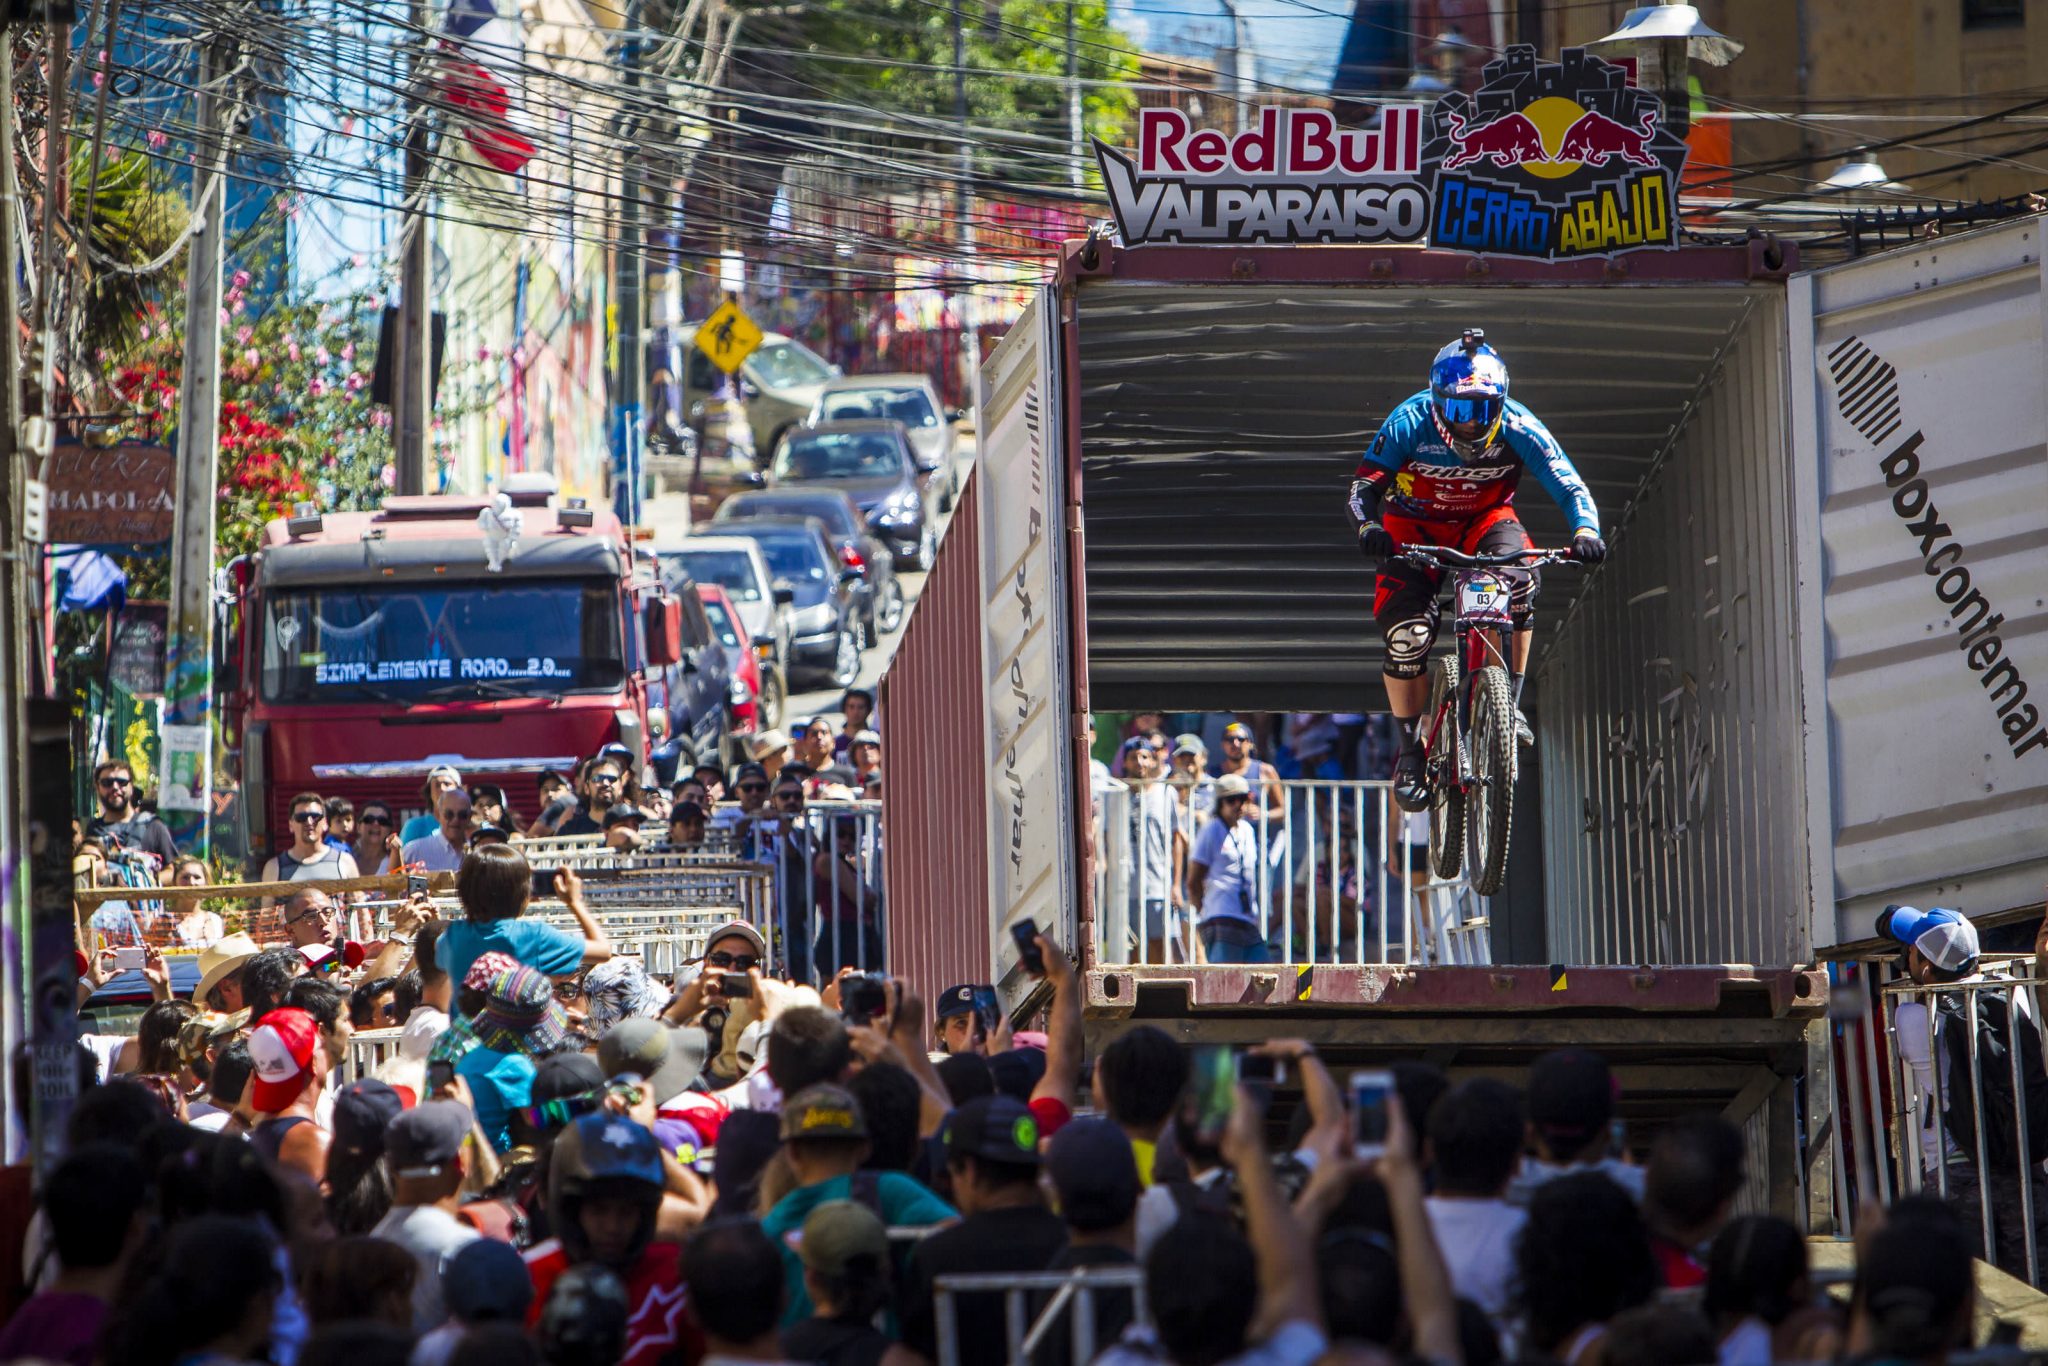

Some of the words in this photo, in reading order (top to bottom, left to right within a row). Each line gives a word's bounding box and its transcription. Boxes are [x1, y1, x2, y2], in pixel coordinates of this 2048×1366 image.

[1140, 108, 1277, 172] Red
[1289, 108, 1420, 172] Bull
[1101, 150, 1428, 243] VALPARAISO
[1438, 180, 1548, 253] CERRO
[1560, 175, 1667, 252] ABAJO
[1477, 593, 1490, 605] 03
[1879, 429, 2048, 760] boxcontemar
[315, 659, 451, 683] SIMPLEMENTE
